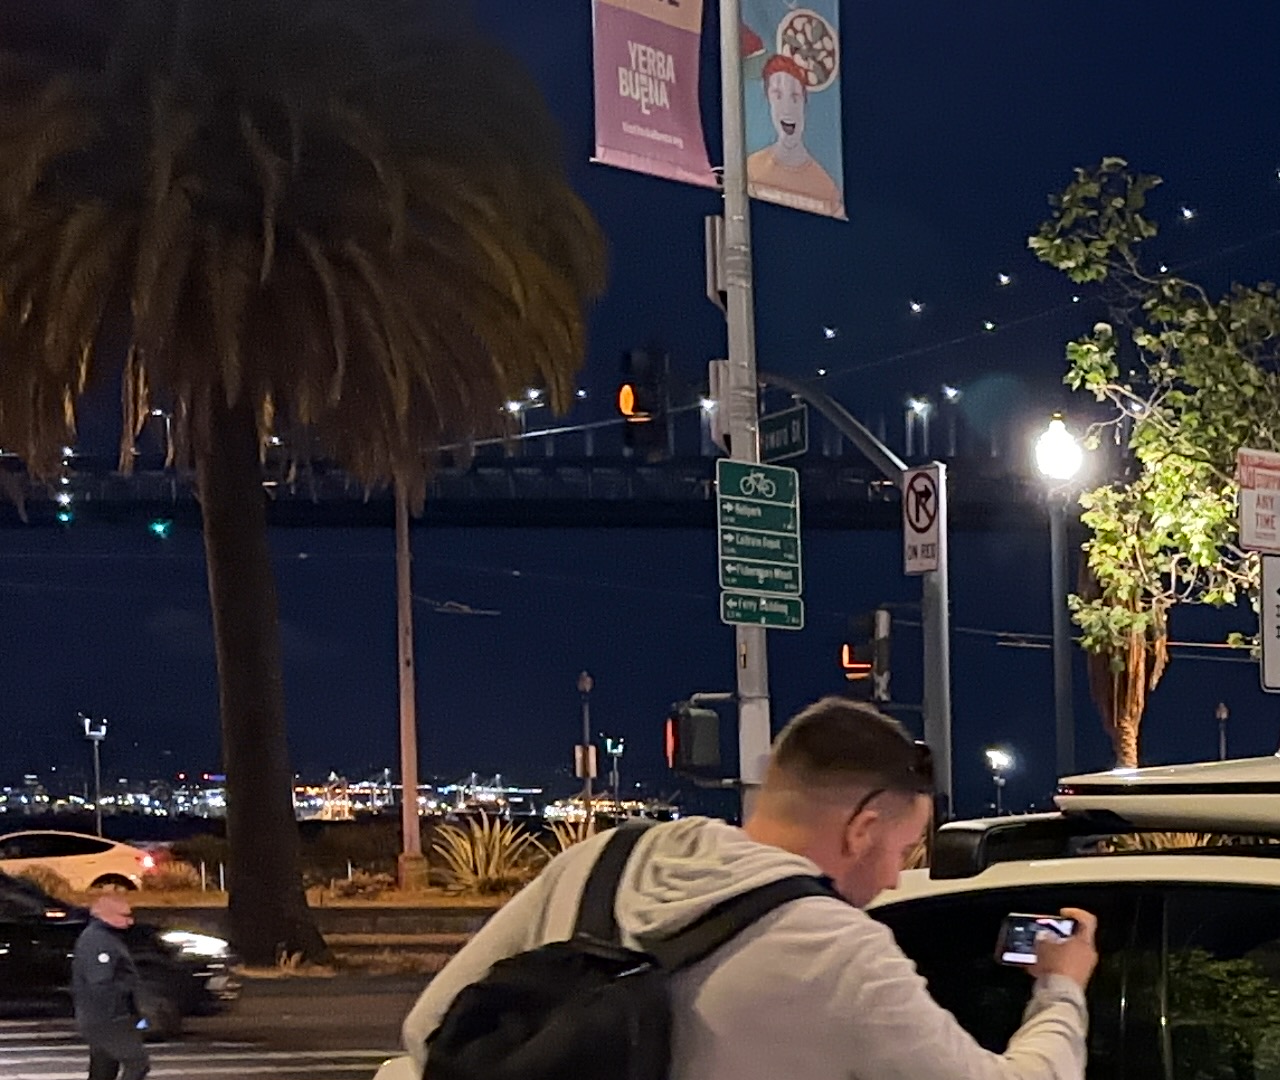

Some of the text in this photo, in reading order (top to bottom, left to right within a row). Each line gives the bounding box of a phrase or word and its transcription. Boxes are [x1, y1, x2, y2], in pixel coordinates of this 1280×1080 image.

[627, 40, 677, 84] YERBA
[618, 66, 670, 115] BUENA
[1255, 494, 1274, 510] ANY
[1255, 512, 1276, 530] TIME
[907, 543, 936, 560] ON RED
